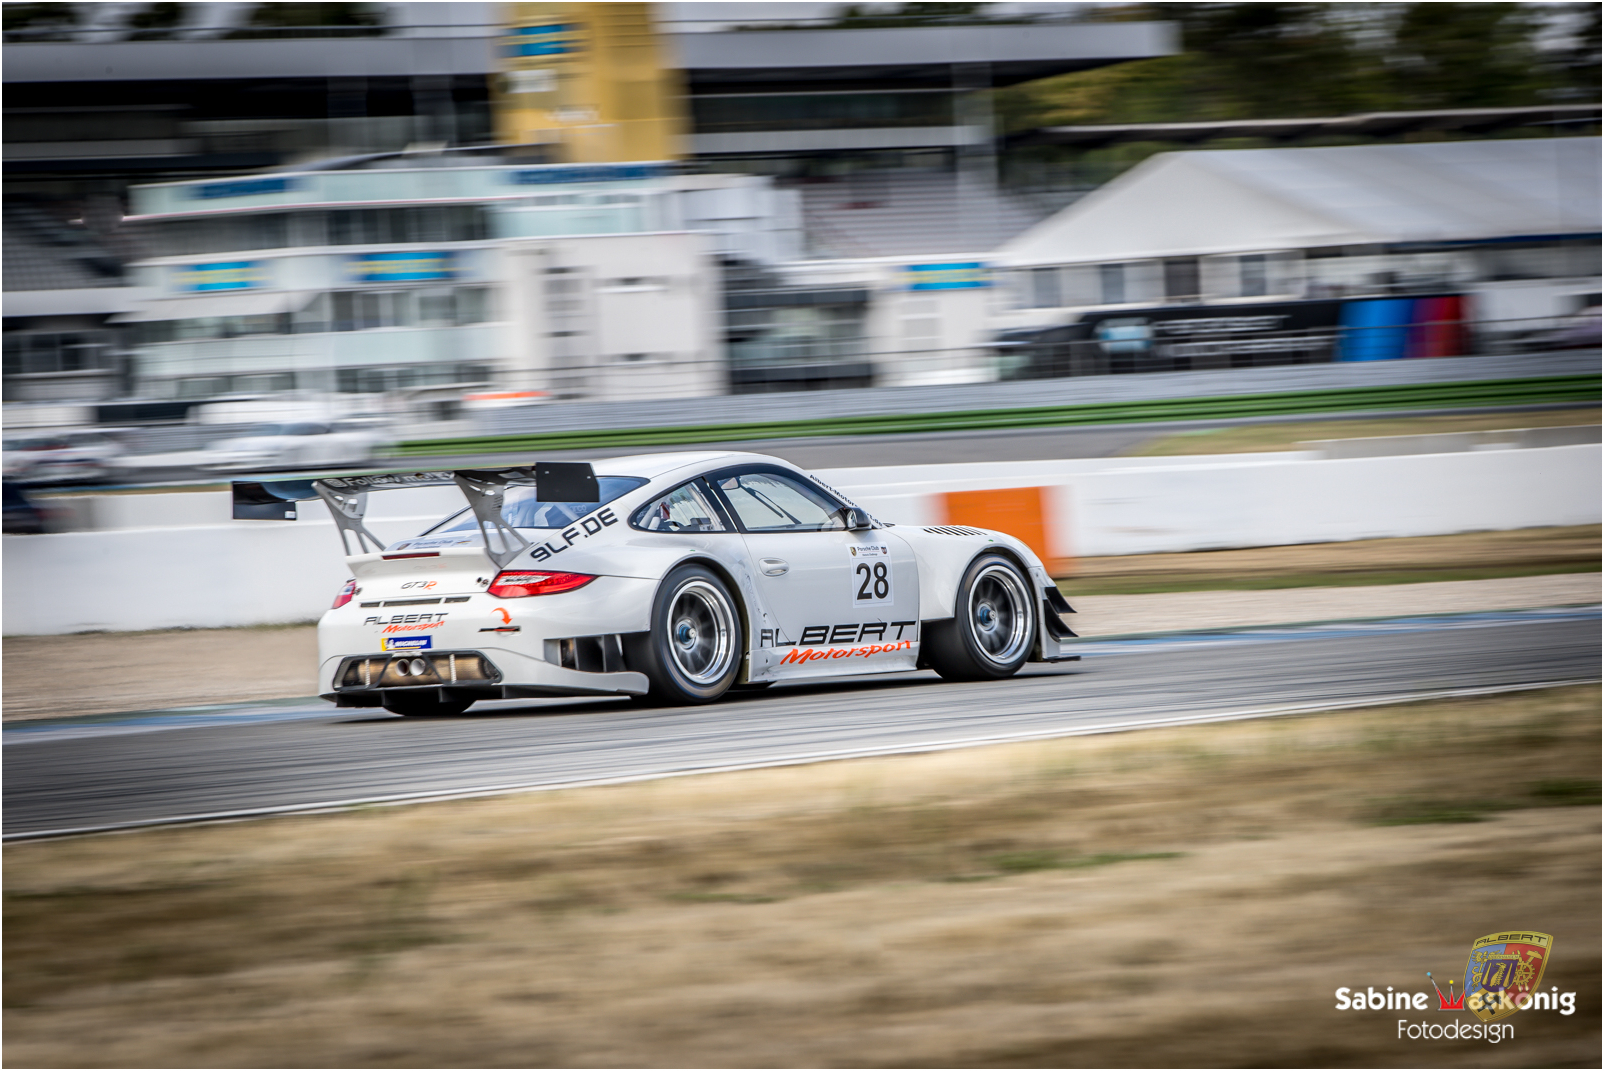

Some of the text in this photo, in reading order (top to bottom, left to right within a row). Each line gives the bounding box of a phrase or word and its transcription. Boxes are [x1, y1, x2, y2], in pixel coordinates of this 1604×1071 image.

[530, 507, 619, 562] 9LF.DE
[856, 561, 889, 600] 28
[363, 612, 449, 626] ALBERT
[381, 620, 446, 634] Motorsport
[760, 620, 917, 647] ALBERT
[780, 640, 911, 665] Motorsport
